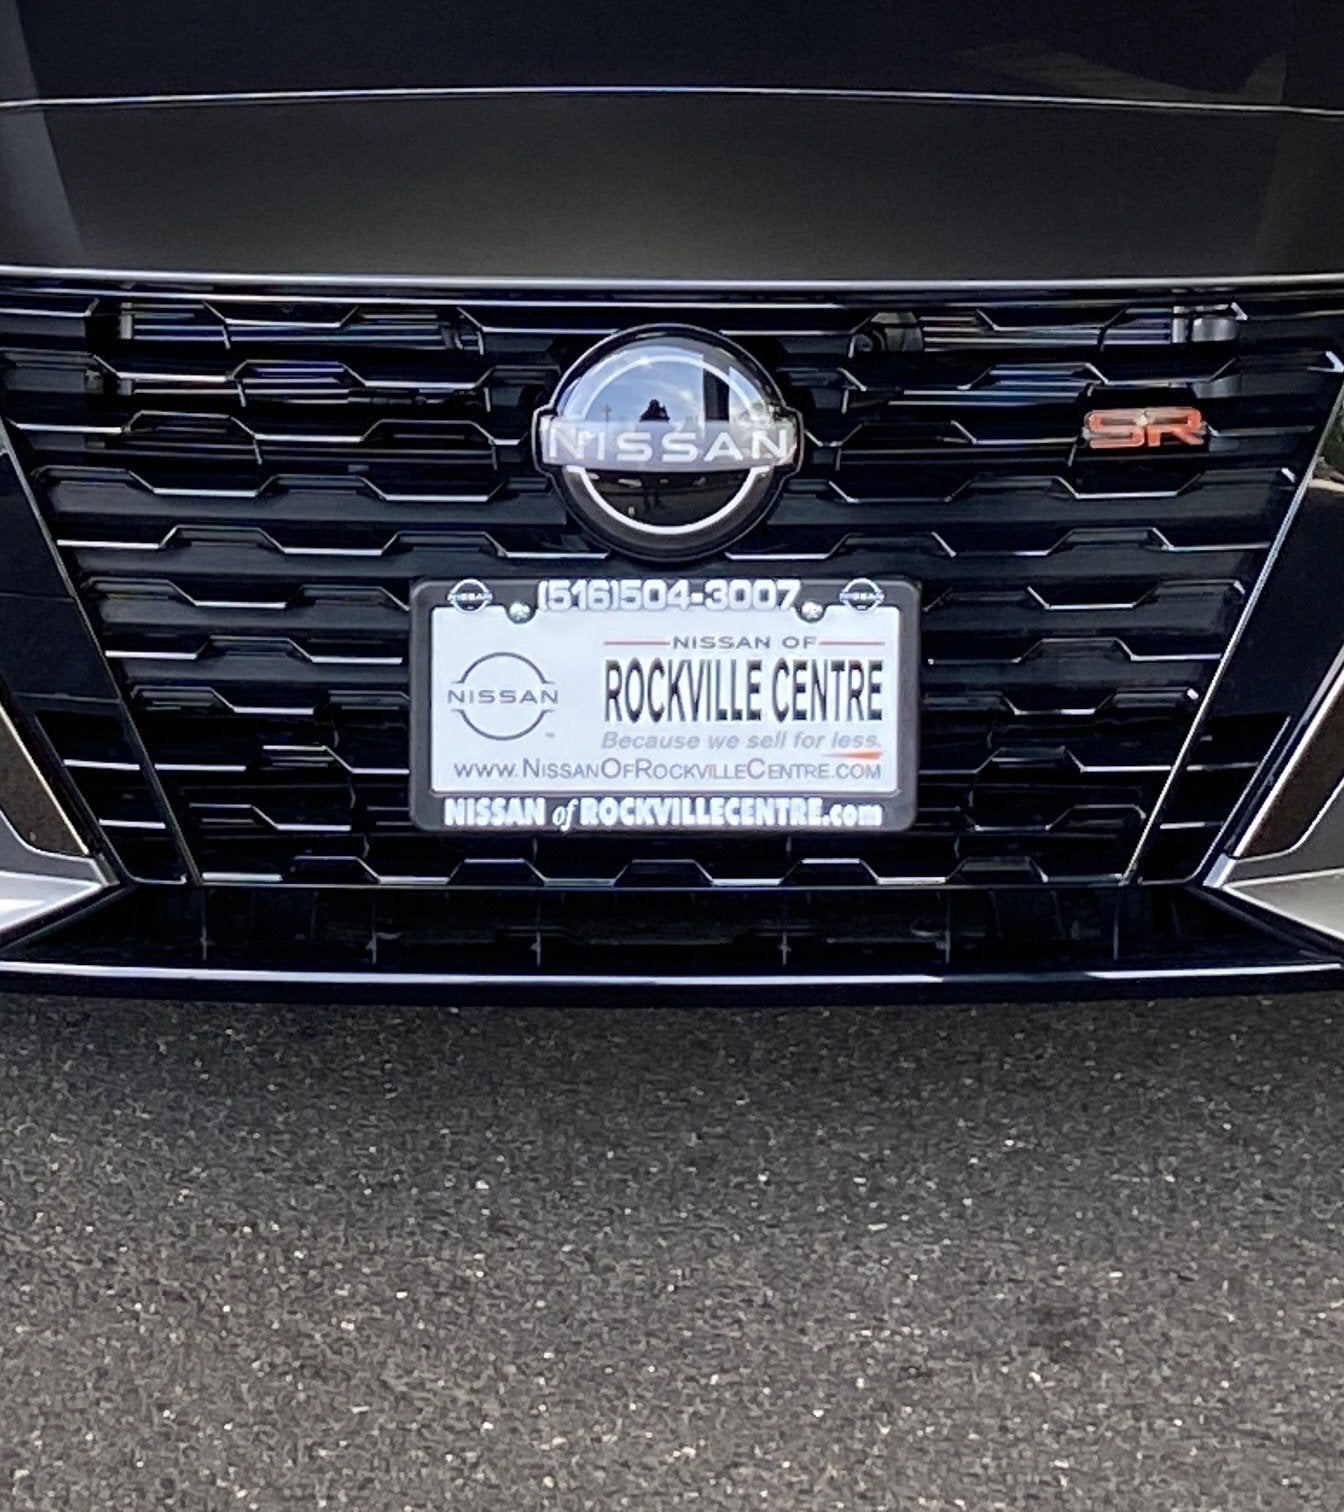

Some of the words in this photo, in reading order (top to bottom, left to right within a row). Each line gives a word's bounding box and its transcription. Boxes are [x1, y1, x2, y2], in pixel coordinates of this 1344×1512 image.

[1084, 406, 1204, 449] SR
[548, 428, 788, 464] NISSAN
[538, 579, 801, 611] (516)504-3007
[672, 635, 771, 650] NISSAN
[781, 636, 818, 649] OF
[447, 689, 559, 704] NISSAN
[604, 657, 763, 723] ROCKVILLE
[771, 657, 884, 723] CENTRE
[601, 731, 700, 749] Because
[708, 735, 740, 749] we
[746, 731, 786, 749] sell
[793, 731, 826, 749] for
[831, 731, 882, 749] less.
[444, 796, 547, 827] NISSAN
[552, 798, 579, 832] of
[579, 796, 884, 827] ROCKVILLECENTRE.com
